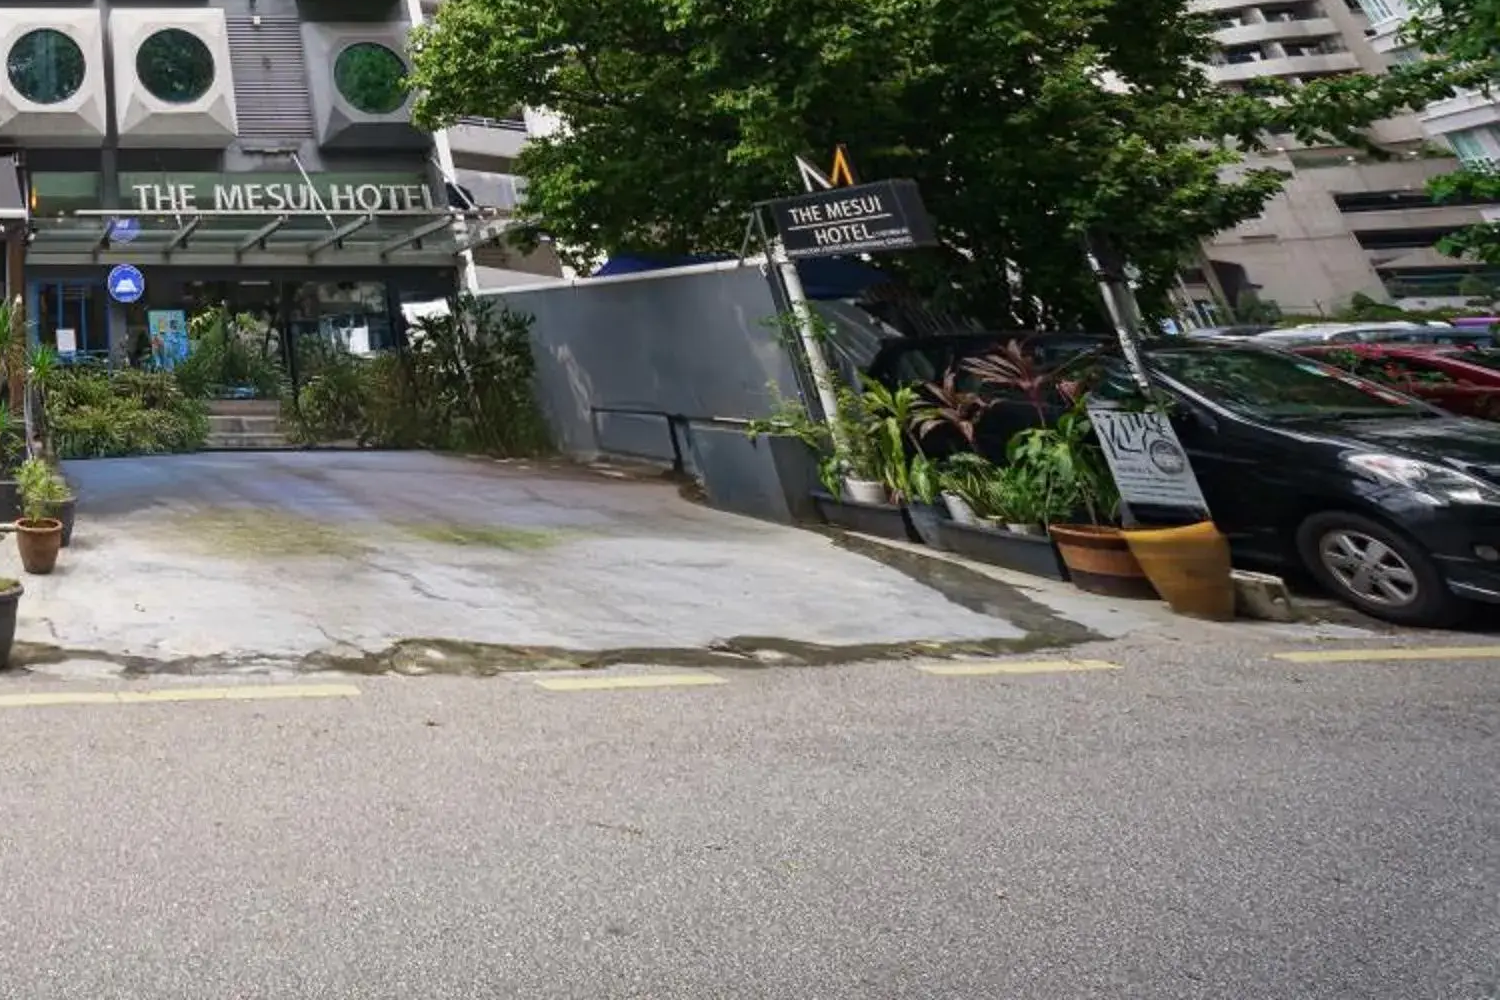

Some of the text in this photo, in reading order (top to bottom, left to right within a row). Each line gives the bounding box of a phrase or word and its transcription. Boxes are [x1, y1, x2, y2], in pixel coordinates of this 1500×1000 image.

[131, 184, 197, 211] THE
[329, 183, 440, 212] HOTEL
[787, 194, 882, 225] THE MESUI
[813, 223, 874, 246] HOTEL
